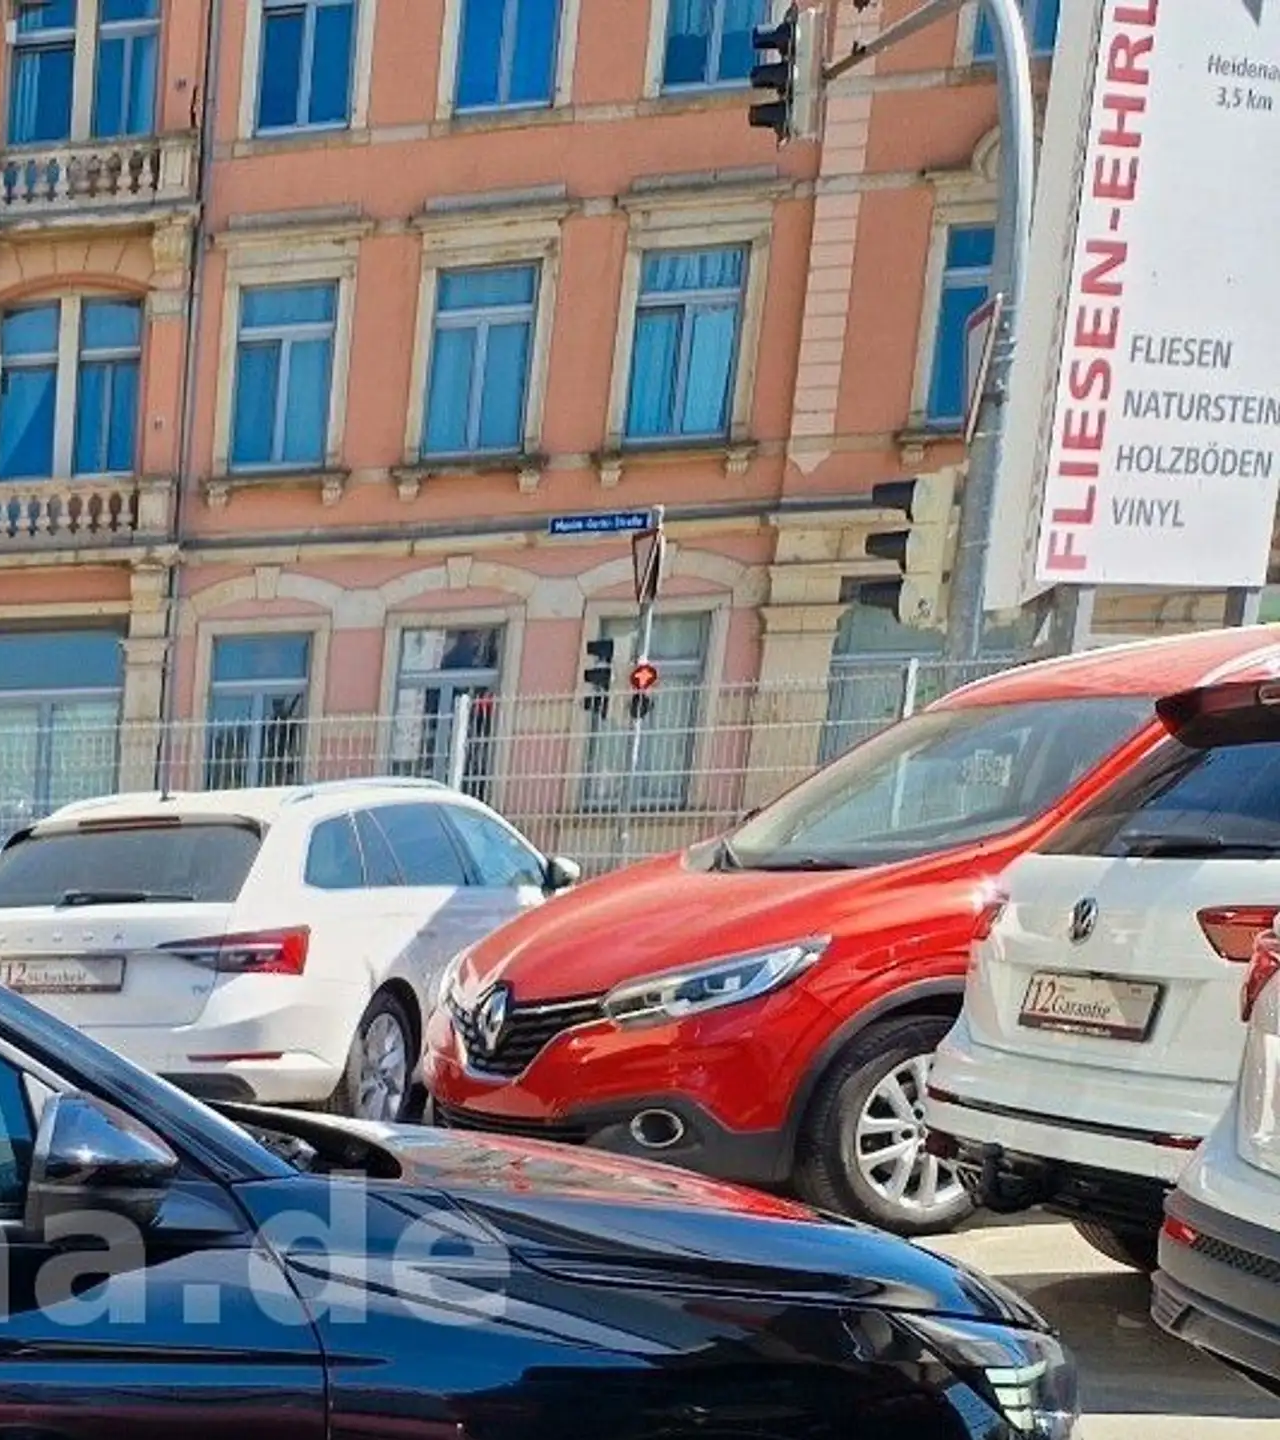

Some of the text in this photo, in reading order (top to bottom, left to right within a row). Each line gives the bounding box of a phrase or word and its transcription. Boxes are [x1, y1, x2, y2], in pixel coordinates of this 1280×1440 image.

[1207, 54, 1280, 81] Heidena
[1217, 86, 1273, 111] 3,5 km
[1130, 335, 1233, 368] FLIESEN
[1122, 389, 1280, 425] NATURSTEIN
[1115, 441, 1273, 478] HOLZBÖDEN
[1112, 496, 1185, 528] VINYL
[1030, 979, 1111, 1019] 12 Garantie
